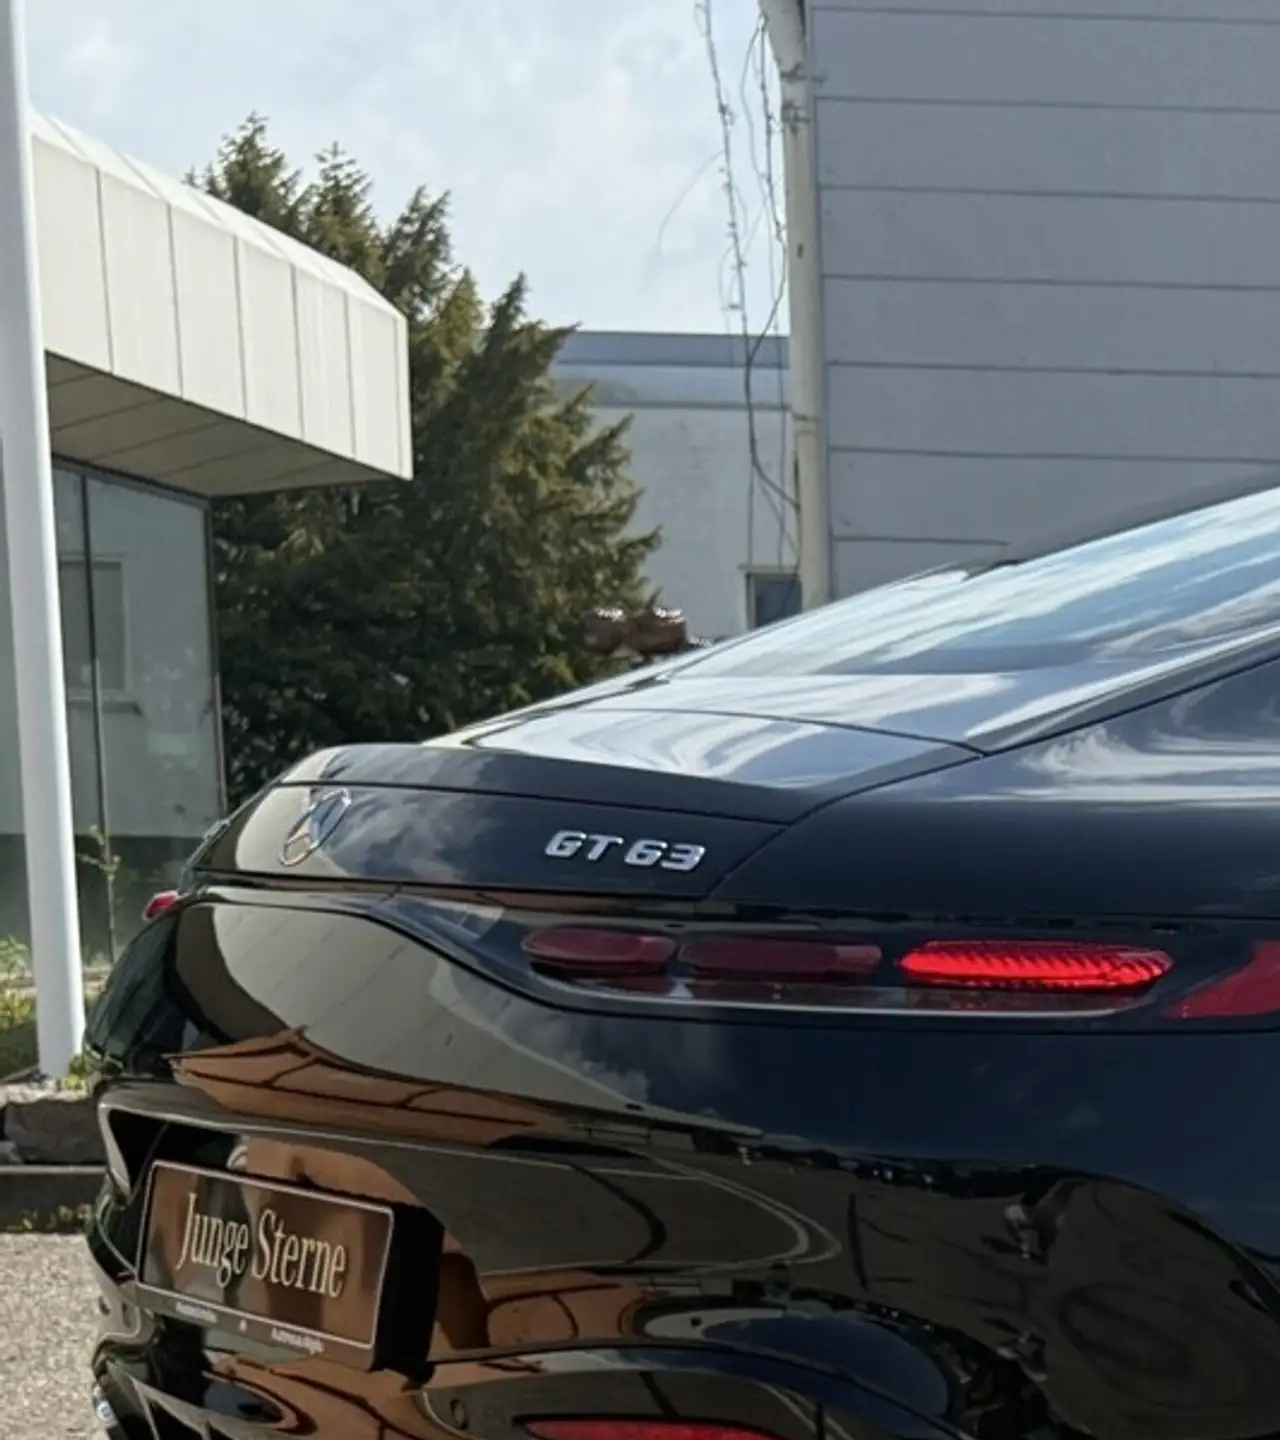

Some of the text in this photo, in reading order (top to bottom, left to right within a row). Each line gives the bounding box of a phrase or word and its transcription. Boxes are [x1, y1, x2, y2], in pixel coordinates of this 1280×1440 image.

[544, 829, 707, 872] GT 63
[174, 1191, 348, 1300] Junge Sterne
